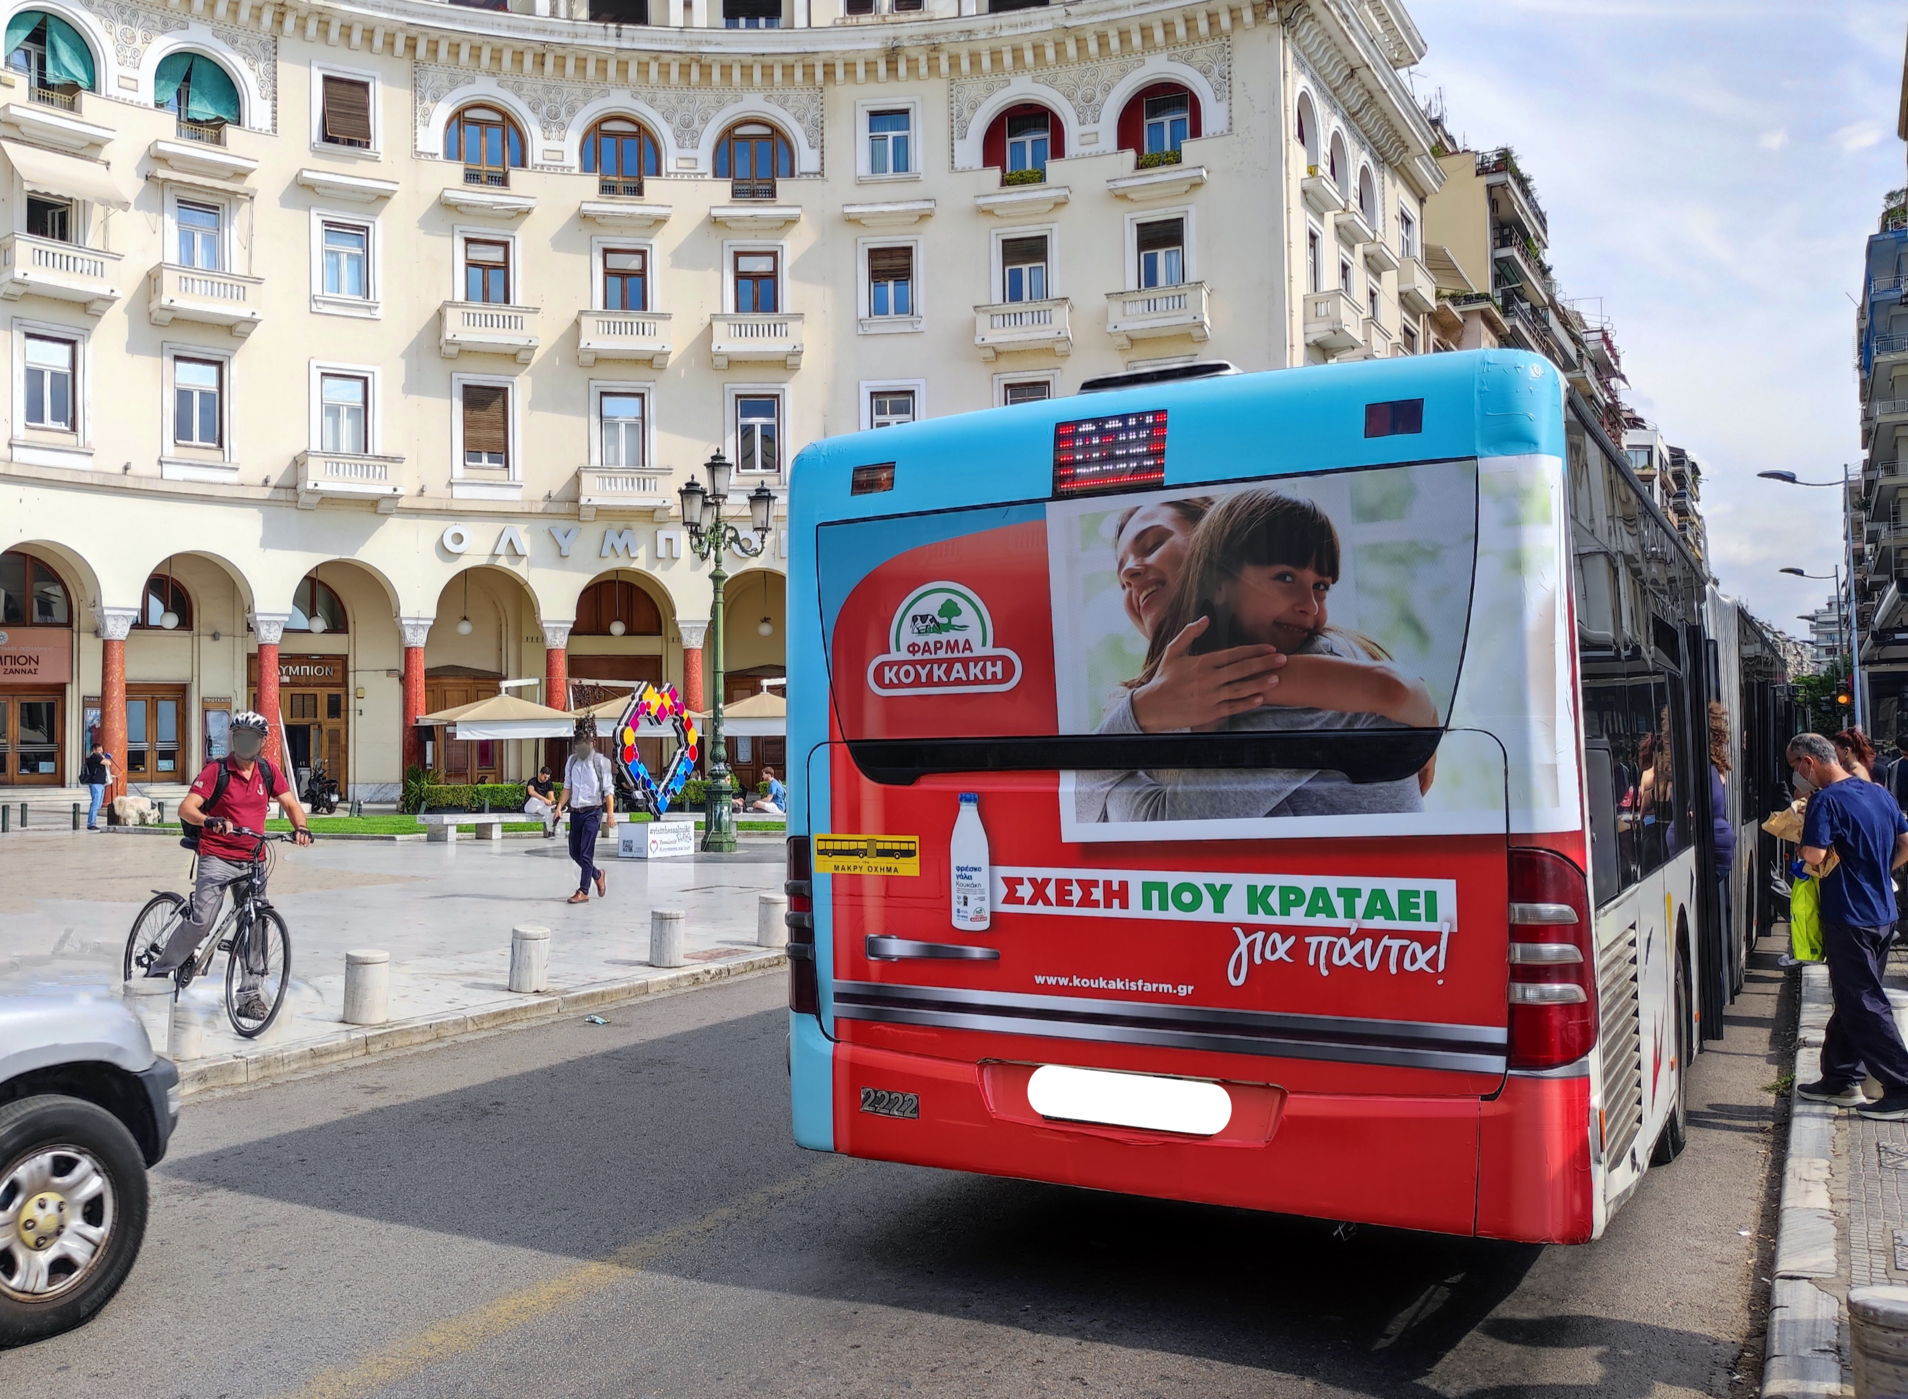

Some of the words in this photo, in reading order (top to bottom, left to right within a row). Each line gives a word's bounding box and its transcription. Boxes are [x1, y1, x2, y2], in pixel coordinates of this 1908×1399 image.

[442, 524, 787, 559] ΟΛΥΜΠΟ
[906, 638, 974, 656] ΦΑΡΜΑ
[884, 660, 1003, 685] ΚΟΥΚΑΚΗ
[867, 865, 899, 874] ΟΧΗΜΑ
[956, 865, 982, 874] φρέσκο
[956, 872, 973, 880] γάλα
[1001, 876, 1129, 910] ΣΧΕΣΗ
[1142, 881, 1233, 914] ΠΟΥ
[1246, 884, 1438, 922] ΚΡΑΤΑΕΙ
[1227, 926, 1296, 987] για
[1304, 921, 1451, 985] πάντα!
[1034, 974, 1194, 997] www.koukakisfarm.gr
[861, 1087, 918, 1118] 2222
